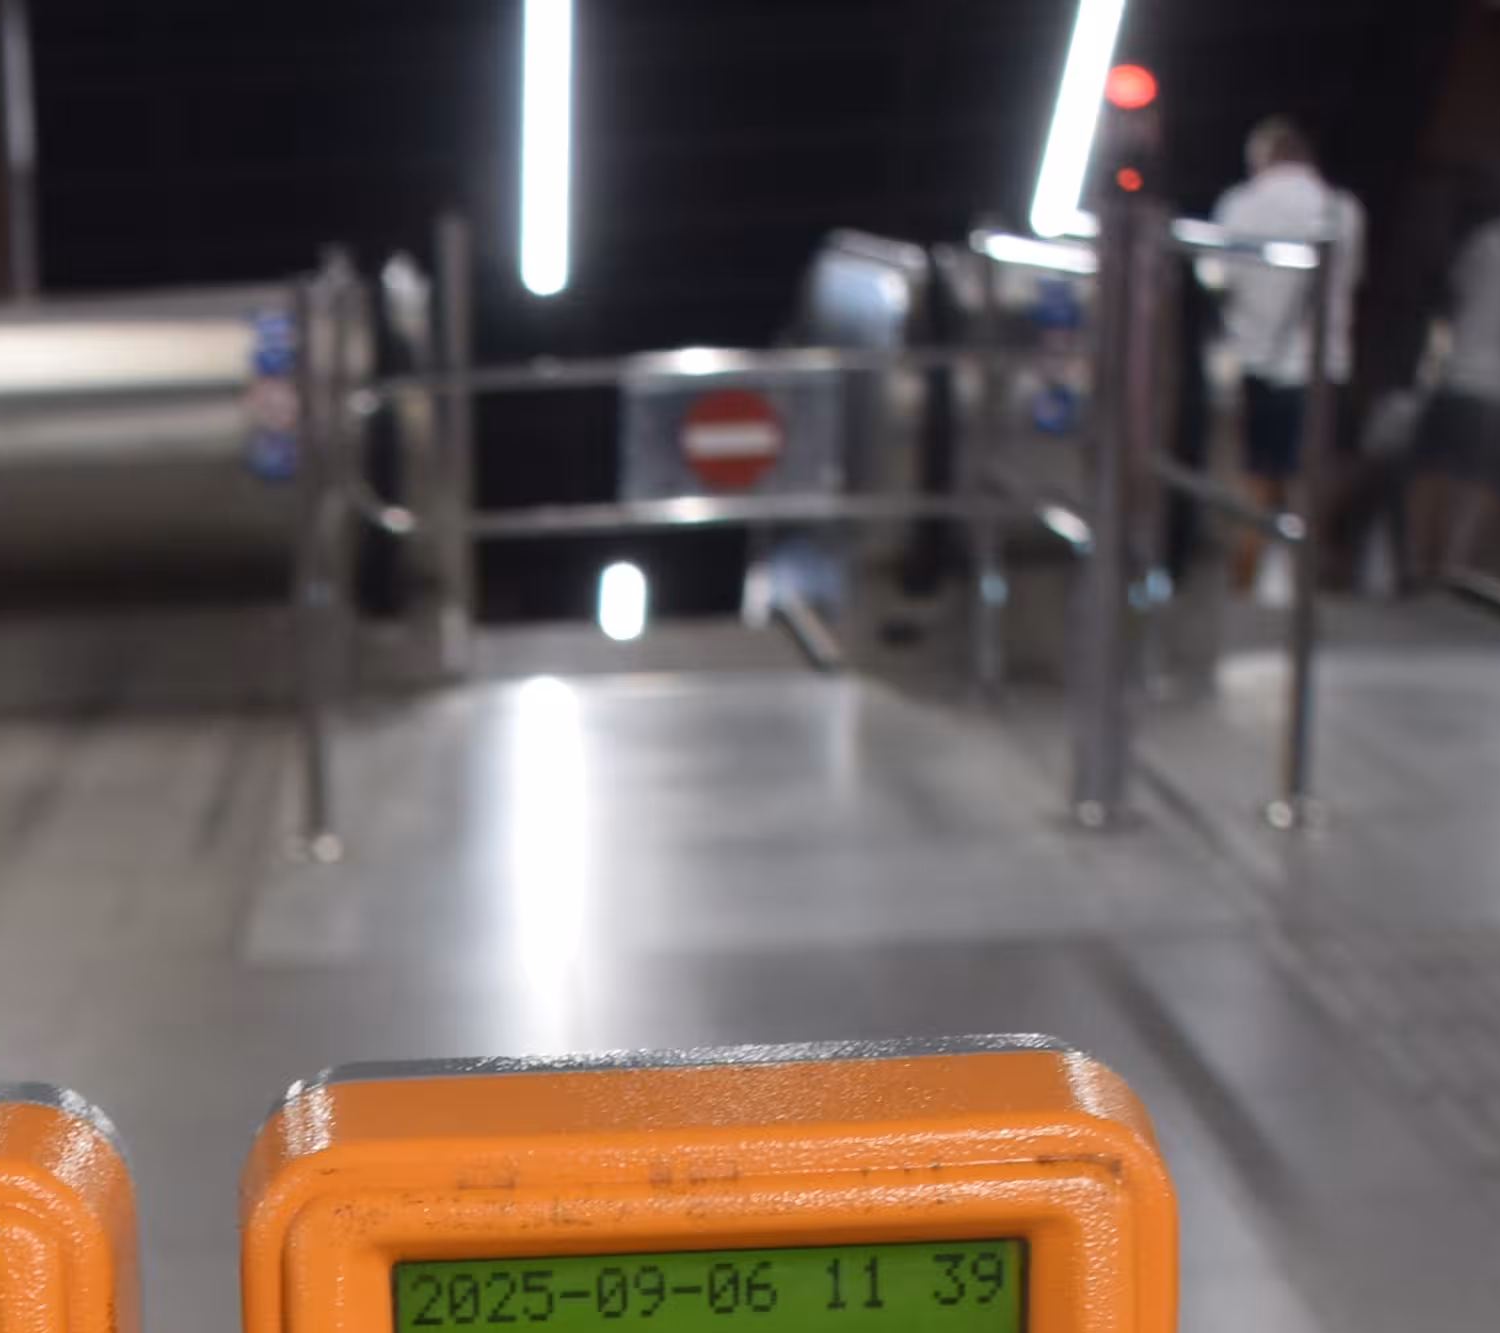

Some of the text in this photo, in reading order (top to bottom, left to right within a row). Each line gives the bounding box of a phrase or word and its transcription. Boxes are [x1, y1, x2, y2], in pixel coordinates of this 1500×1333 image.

[411, 1251, 1003, 1326] 2025-09-06 11 39
